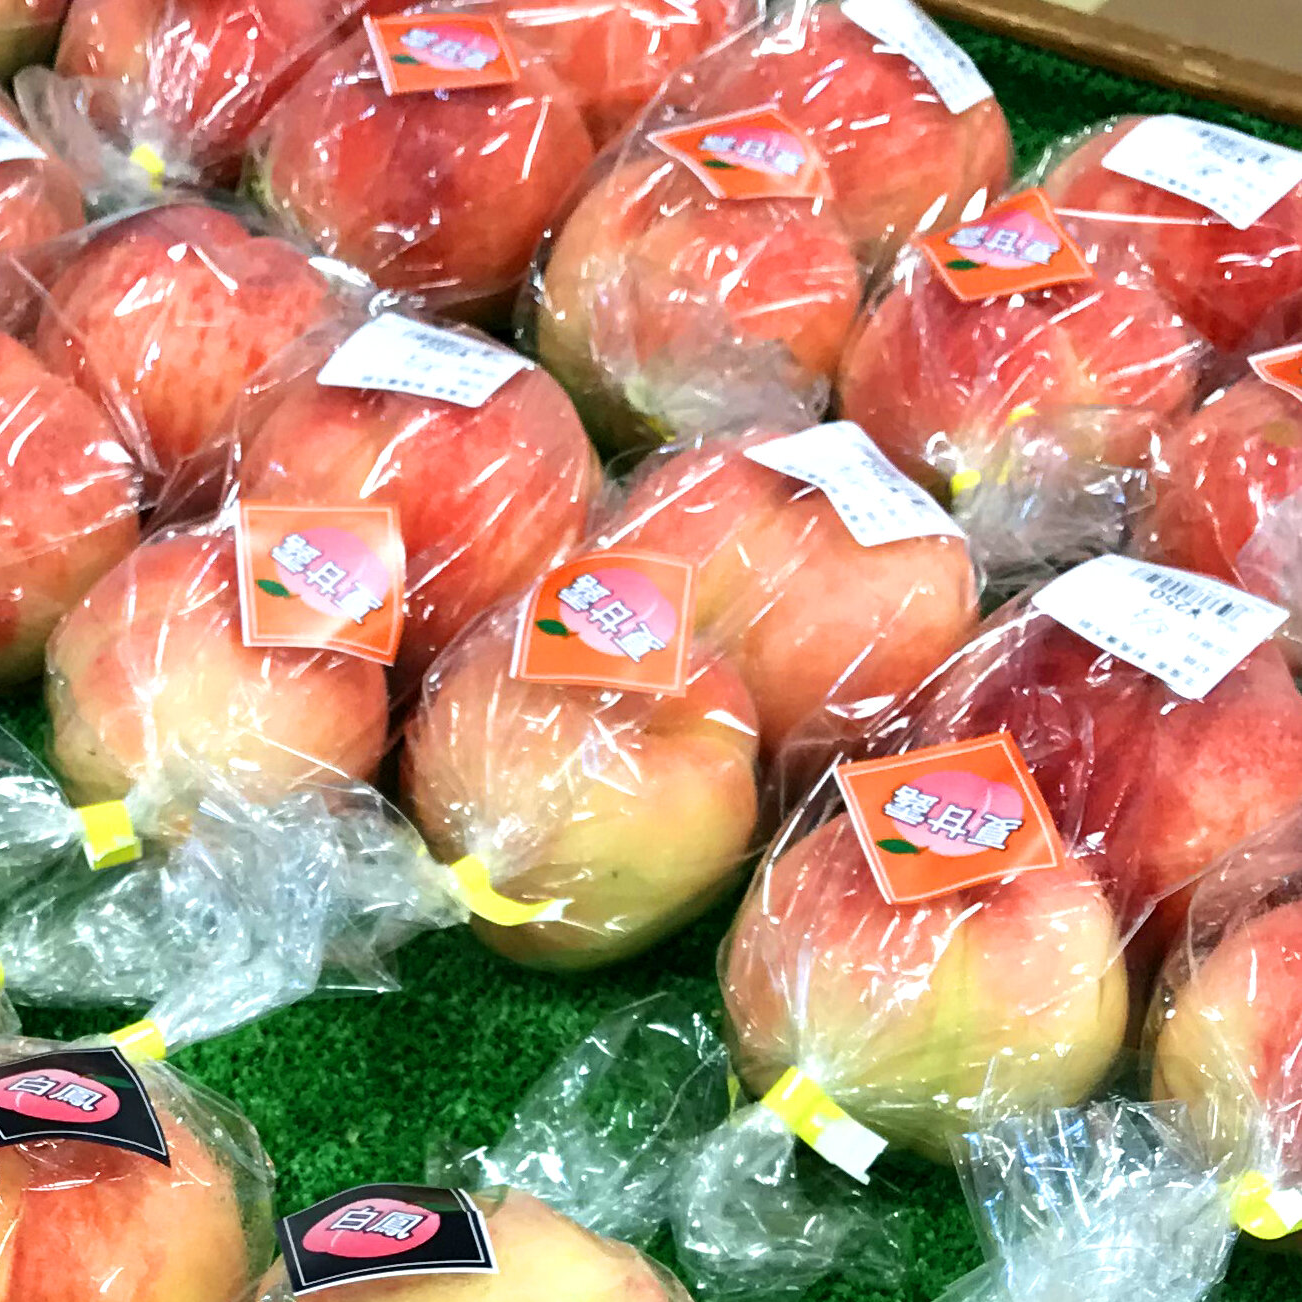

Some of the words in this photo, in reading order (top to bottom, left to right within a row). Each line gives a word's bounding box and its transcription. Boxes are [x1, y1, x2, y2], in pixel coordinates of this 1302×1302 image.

[558, 573, 667, 662] 夏甘露
[882, 784, 1023, 851] 夏甘露
[8, 1074, 107, 1112] 白鳳
[337, 1206, 425, 1242] 白鳳
